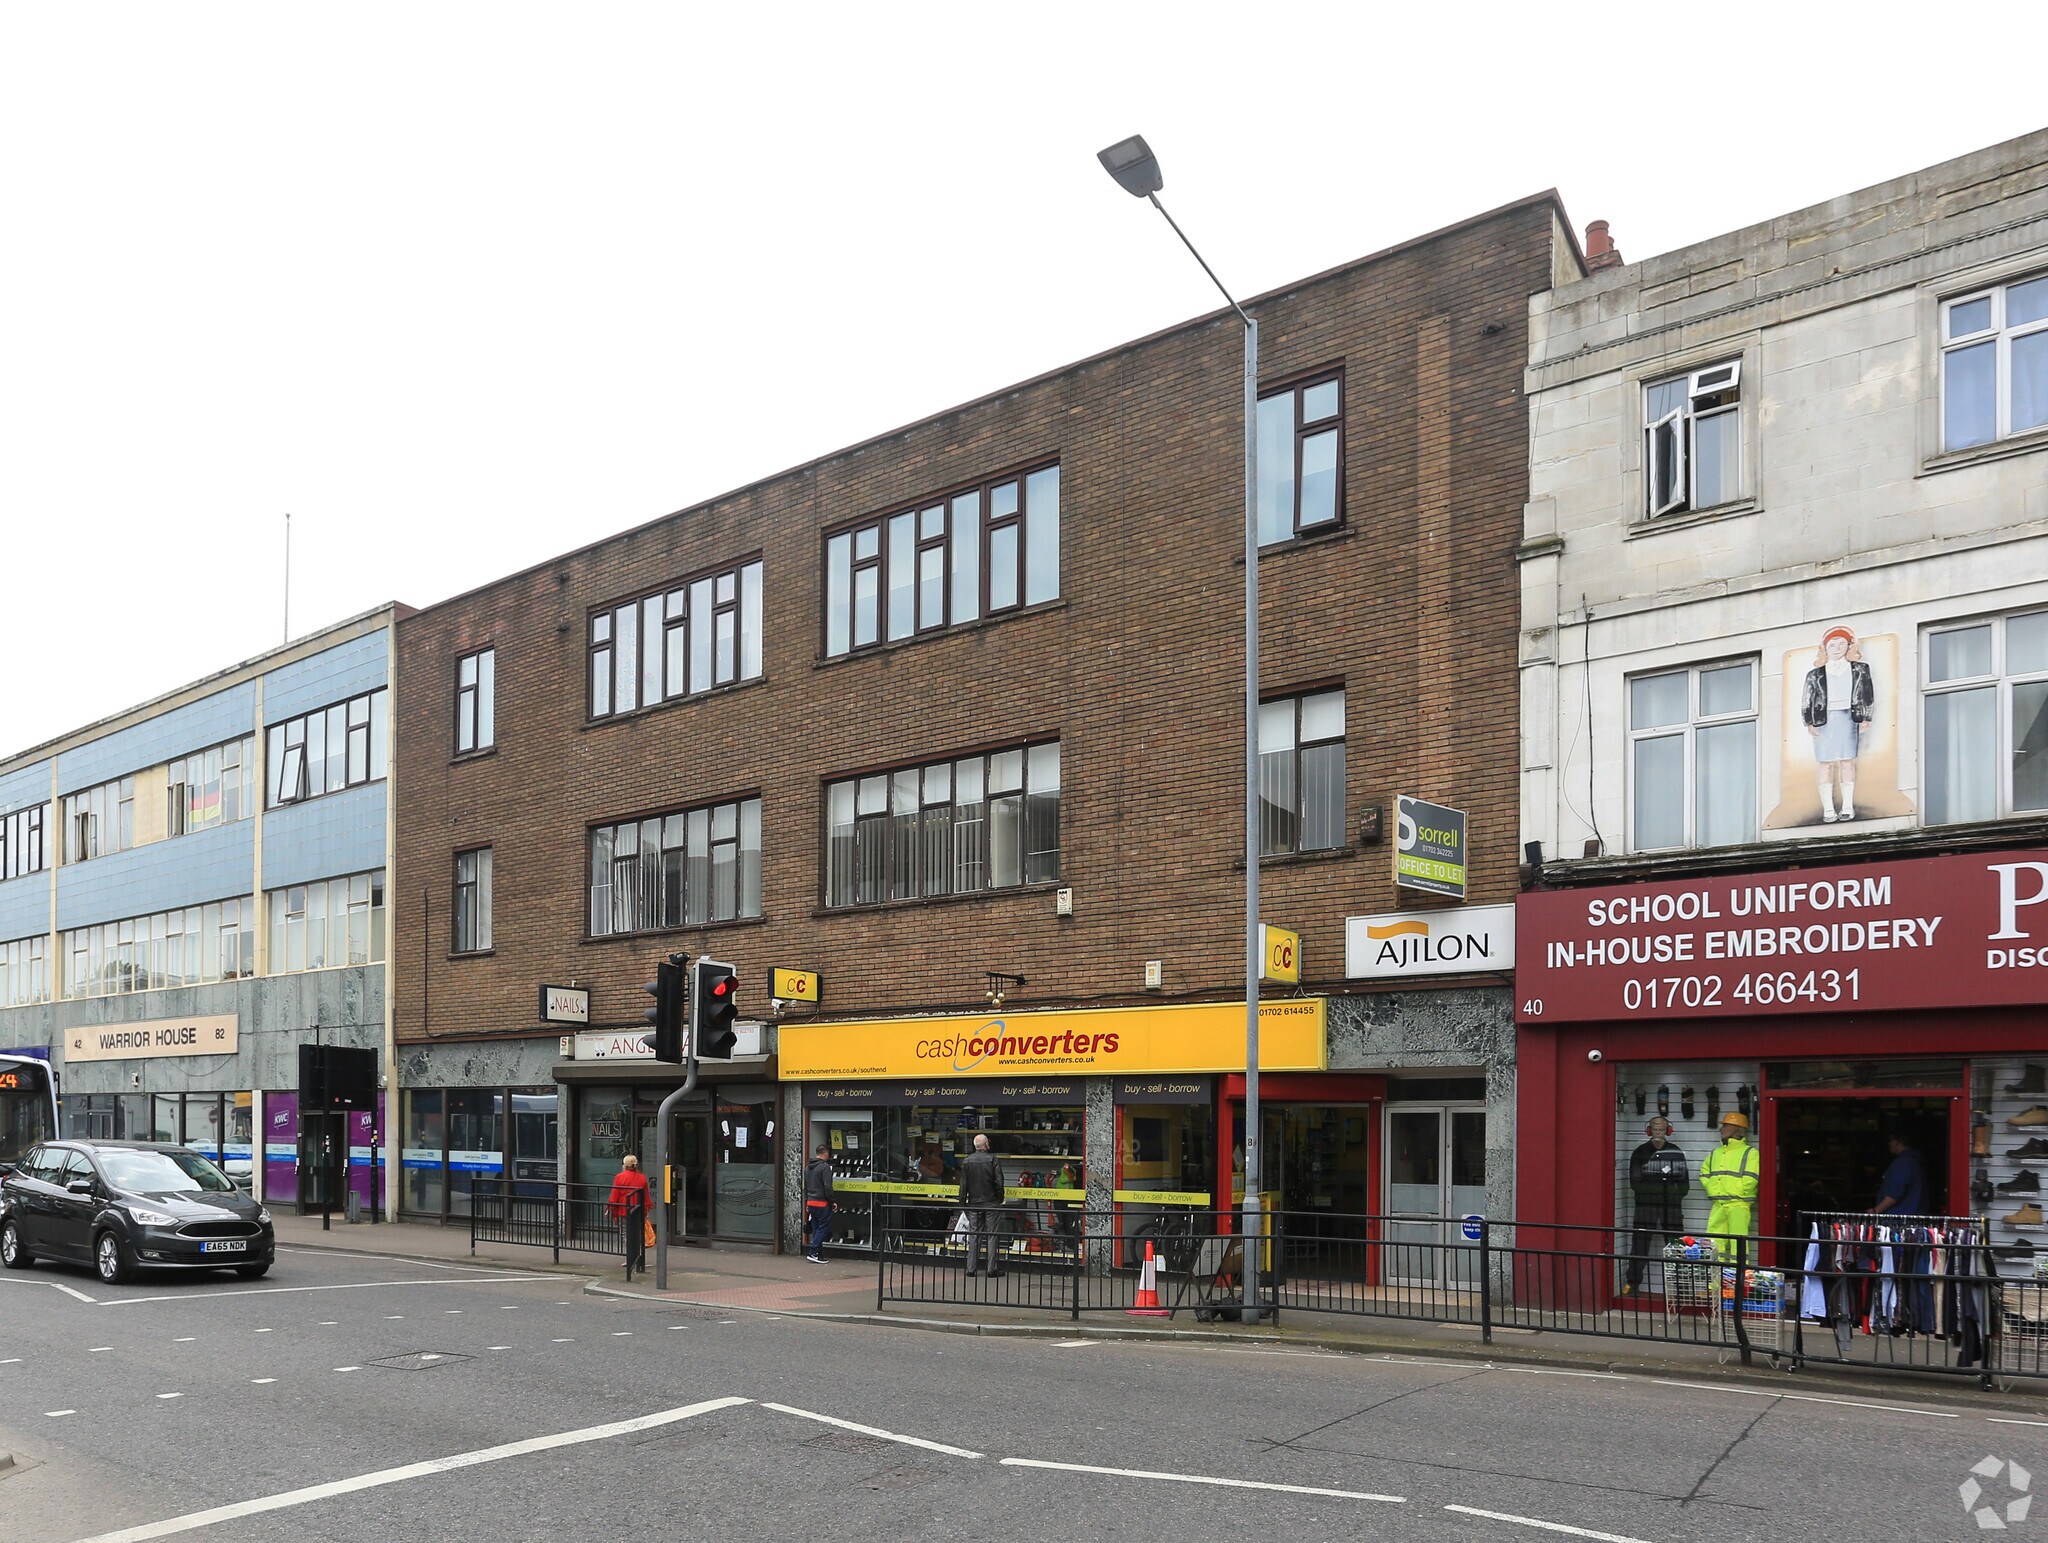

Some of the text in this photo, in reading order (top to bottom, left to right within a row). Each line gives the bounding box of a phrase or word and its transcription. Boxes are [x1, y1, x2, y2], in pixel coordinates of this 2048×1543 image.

[1419, 826, 1458, 848] sorrell
[1422, 844, 1436, 855] 01702
[1400, 857, 1463, 882] OFFICE TO LET
[1587, 876, 1892, 927] SCHOOL UNIFORM
[1986, 861, 2048, 940] P
[1546, 916, 1943, 969] IN-HOUSE EMBROIDERY
[1375, 932, 1489, 968] AJILON
[1622, 968, 1861, 1011] 01702 466431
[555, 996, 580, 1014] NAILS
[1522, 998, 1544, 1017] 40
[1259, 1006, 1315, 1017] 01702 614455
[100, 1027, 197, 1050] WARRIOR HOUSE
[214, 1028, 226, 1040] 82
[74, 1039, 82, 1049] 42
[998, 1056, 1096, 1066] www.cashconverters.co.uk
[785, 1066, 887, 1075] www.cashconverters.co.uk/southend
[817, 1088, 874, 1099] buy sell borrow
[905, 1086, 967, 1098] buy sell borrow
[1002, 1085, 1071, 1097] buy sell borrow
[1124, 1083, 1200, 1095] buy sell borrow
[274, 1112, 289, 1124] KWC
[361, 1114, 372, 1126] KW
[592, 1122, 621, 1137] NAILS
[906, 1184, 926, 1192] borrow
[1006, 1189, 1059, 1198] buy sell borrow
[1133, 1192, 1193, 1202] buy sell borrow
[206, 1241, 246, 1251] EA65 NDK
